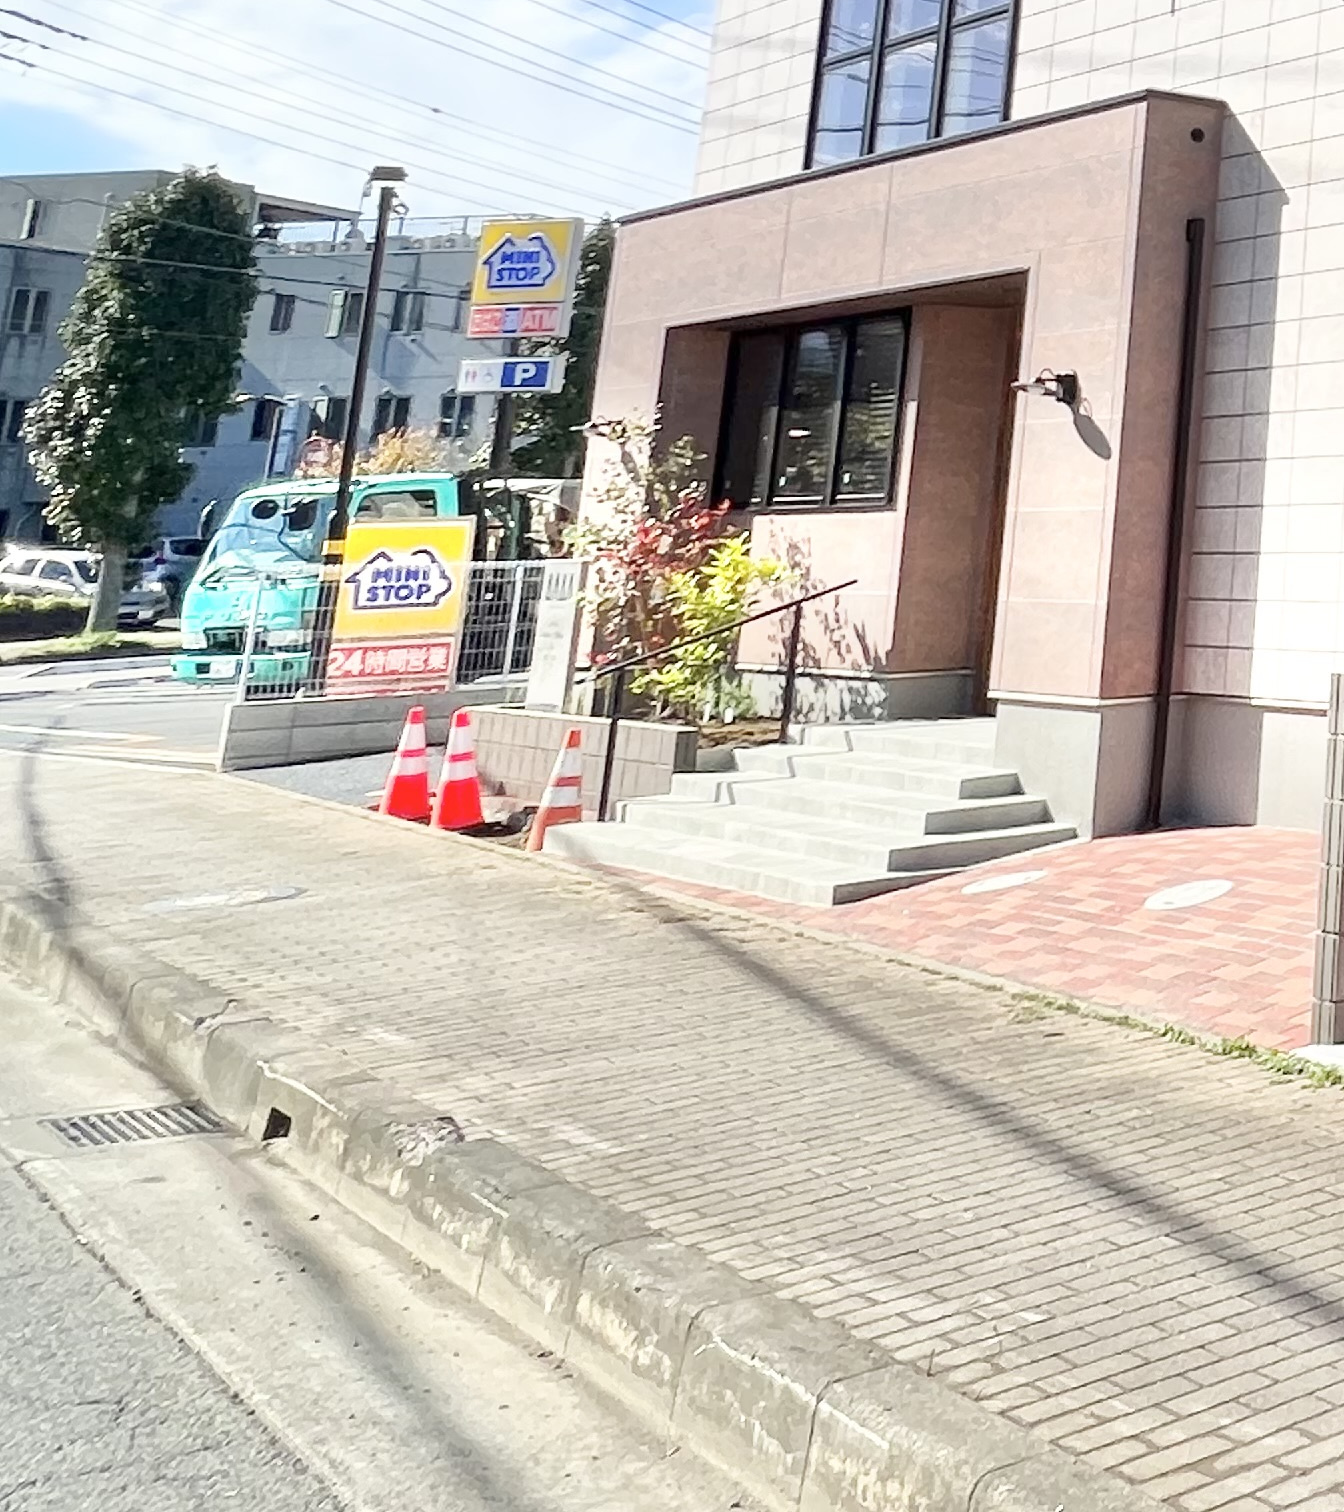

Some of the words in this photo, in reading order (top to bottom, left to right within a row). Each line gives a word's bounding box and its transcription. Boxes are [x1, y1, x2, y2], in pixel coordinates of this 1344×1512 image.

[501, 251, 540, 264] MINI
[495, 267, 541, 282] STOP
[522, 309, 558, 330] ATM
[514, 363, 537, 386] P
[371, 565, 431, 584] MINI
[365, 584, 432, 602] STOP
[328, 646, 449, 677] 24時間営業
